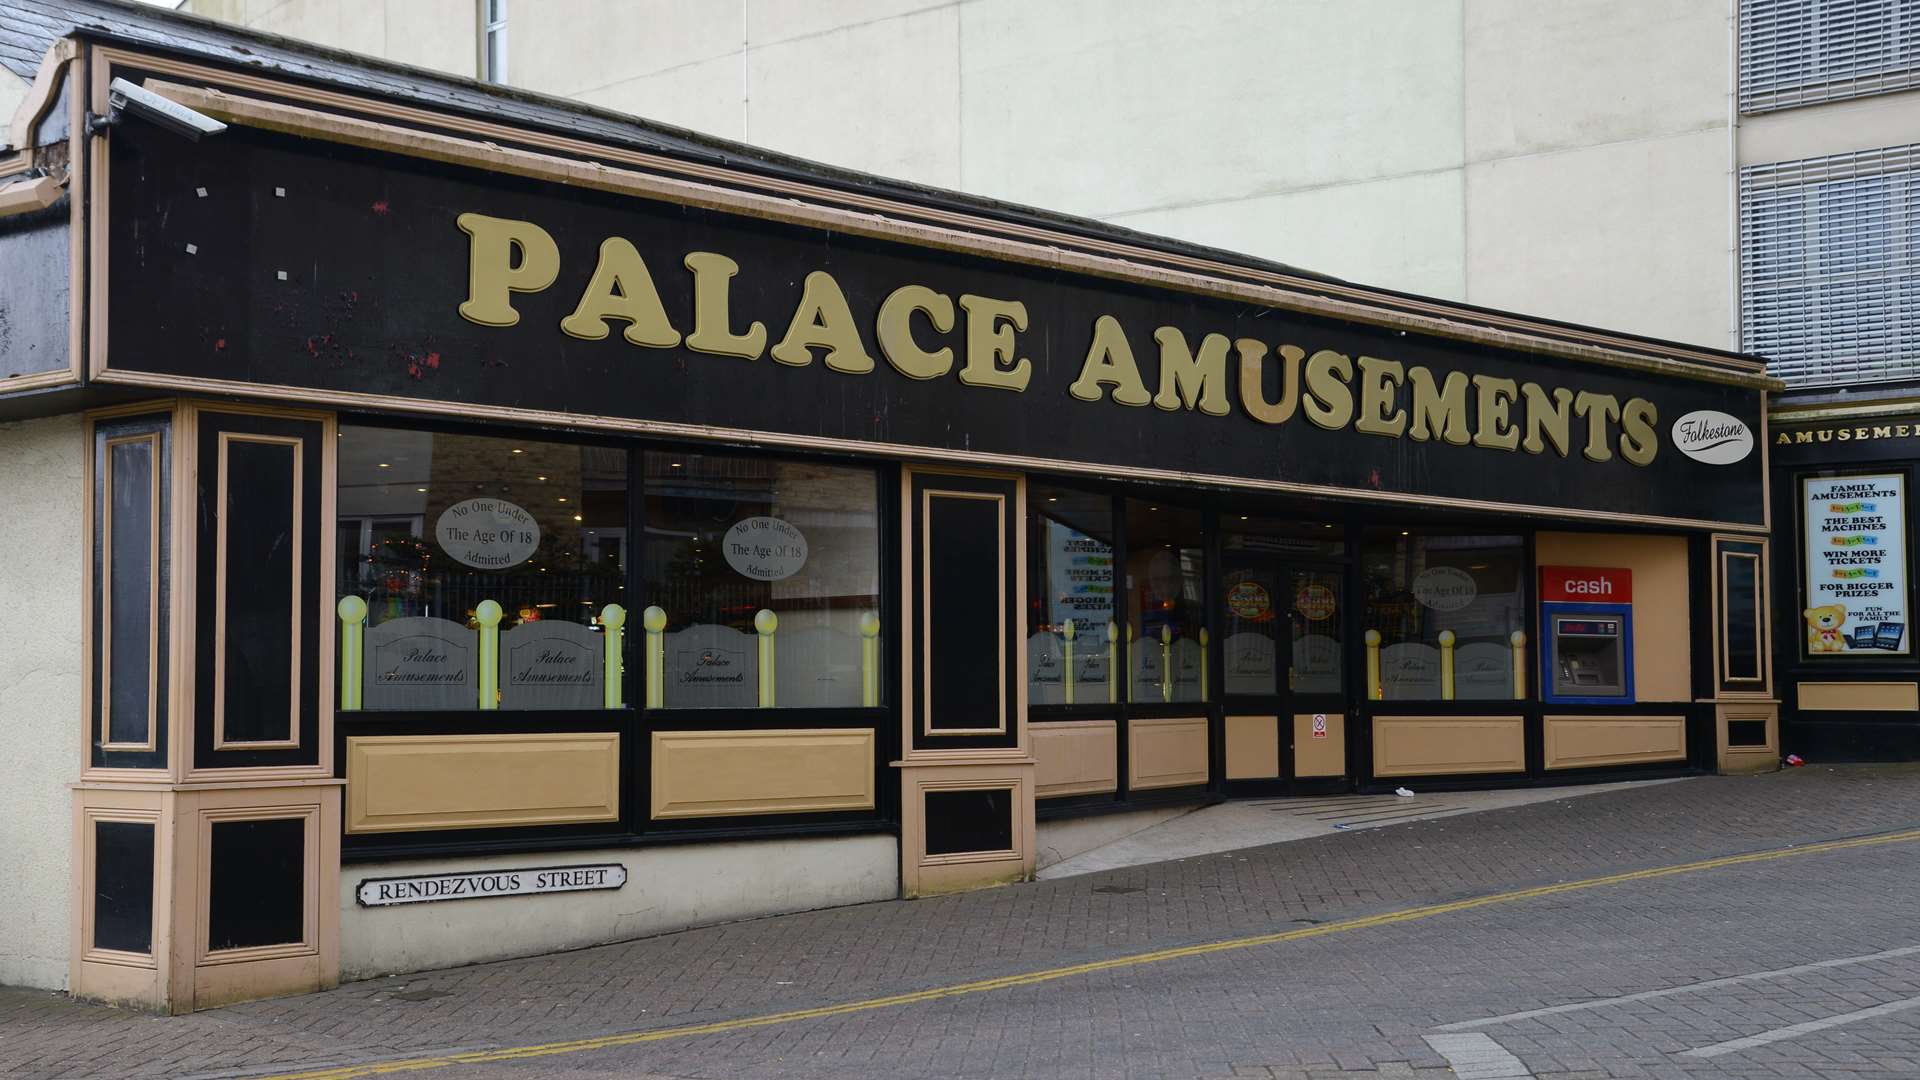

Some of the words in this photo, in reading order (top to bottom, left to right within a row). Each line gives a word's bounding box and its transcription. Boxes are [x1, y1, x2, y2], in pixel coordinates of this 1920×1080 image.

[457, 212, 1032, 392] PALACE
[1070, 315, 1658, 466] AMUSEMENTS
[1680, 417, 1744, 444] Folkestone
[1811, 490, 1897, 501] AMUSEMENTS
[1831, 484, 1876, 493] FAMILY
[451, 506, 468, 519] No
[471, 501, 494, 513] One
[496, 502, 529, 525] Under
[1825, 517, 1849, 525] THE
[1852, 516, 1883, 524] BEST
[446, 527, 469, 540] The
[473, 529, 496, 544] Age
[500, 530, 516, 543] Of
[519, 531, 532, 544] 18
[735, 523, 749, 537] No
[751, 519, 769, 530] One
[1822, 523, 1887, 532] MACHINES
[464, 549, 511, 566] Admitted
[731, 543, 750, 555] The
[753, 545, 772, 559] Age
[775, 545, 788, 557] Of
[791, 546, 802, 558] 18
[1823, 551, 1848, 559] WIN
[1851, 550, 1887, 558] MORE
[1828, 557, 1882, 565] TICKETS
[1564, 576, 1612, 594] cash
[1820, 583, 1844, 591] FOR
[1847, 582, 1894, 590] BIGGER
[402, 647, 447, 664] Palace
[536, 649, 577, 665] Palace
[696, 650, 731, 667] Palace
[378, 665, 464, 683] Amusements
[513, 666, 592, 683] Amusements
[680, 667, 744, 684] Amusements
[378, 874, 520, 900] RENDEZVOUS
[535, 869, 608, 888] STREET
